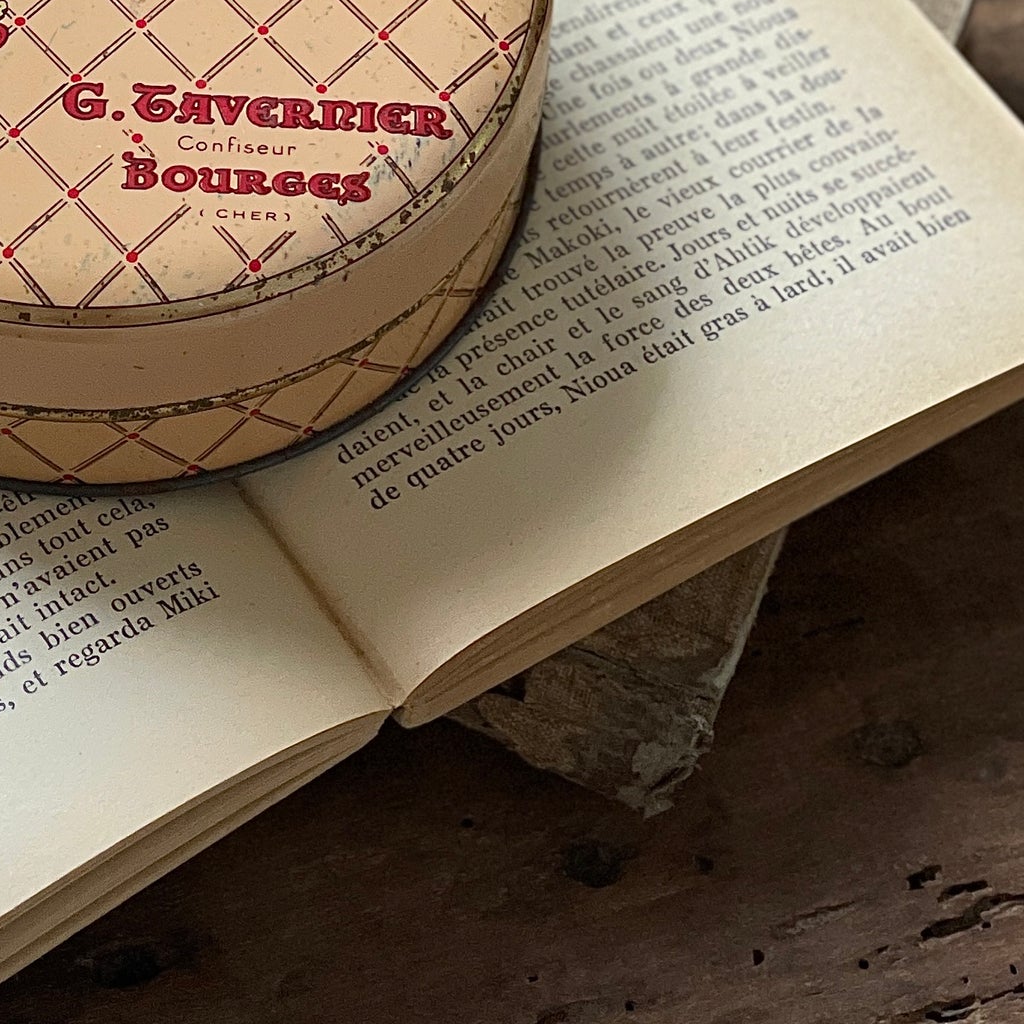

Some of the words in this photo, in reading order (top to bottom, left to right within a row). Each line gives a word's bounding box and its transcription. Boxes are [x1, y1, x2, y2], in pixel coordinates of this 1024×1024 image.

[62, 82, 126, 122] G.
[177, 135, 297, 157] Confiseur
[543, 141, 606, 174] cette
[610, 116, 661, 148] nuit
[662, 85, 737, 124] étoilée
[761, 44, 831, 81] veiller
[543, 165, 615, 203] temps
[713, 100, 768, 129] dans
[765, 88, 796, 107] la
[521, 217, 622, 270] Makoki,
[622, 206, 651, 224] le
[656, 175, 722, 208] vieux
[727, 132, 816, 180] courrier
[823, 118, 854, 138] de
[853, 105, 884, 124] la
[337, 411, 421, 465] daient,
[428, 389, 454, 412] et
[455, 376, 489, 396] la
[496, 337, 558, 376] chair
[567, 317, 593, 340] et
[594, 306, 624, 325] le
[631, 275, 689, 309] sang
[693, 234, 778, 280] d'Ahtik
[785, 164, 936, 240] développaient
[351, 363, 561, 490] merveilleusement
[563, 350, 596, 371] la
[601, 317, 665, 352] force
[673, 293, 713, 319] des
[722, 263, 780, 296] deux
[859, 211, 895, 237] Au
[896, 184, 954, 218] bout
[453, 308, 558, 373] présence
[560, 260, 666, 312] tutélaire.
[666, 227, 732, 262] Jours
[736, 211, 760, 232] et
[760, 189, 819, 221] nuits
[820, 177, 848, 196] se
[368, 482, 402, 510] de
[406, 438, 486, 490] quatre
[487, 401, 562, 447] jours,
[558, 361, 638, 404] Nioua
[641, 329, 695, 364] était
[700, 307, 749, 342] gras
[750, 294, 772, 312] à
[769, 268, 834, 303] lard;
[832, 254, 856, 275] il
[860, 229, 918, 264] avait
[915, 209, 972, 238] bien
[122, 517, 170, 549] pas
[22, 669, 49, 694] et
[52, 613, 158, 677] regarda
[155, 572, 220, 622] Miki
[37, 612, 100, 651] bien
[110, 562, 202, 615] ouverts
